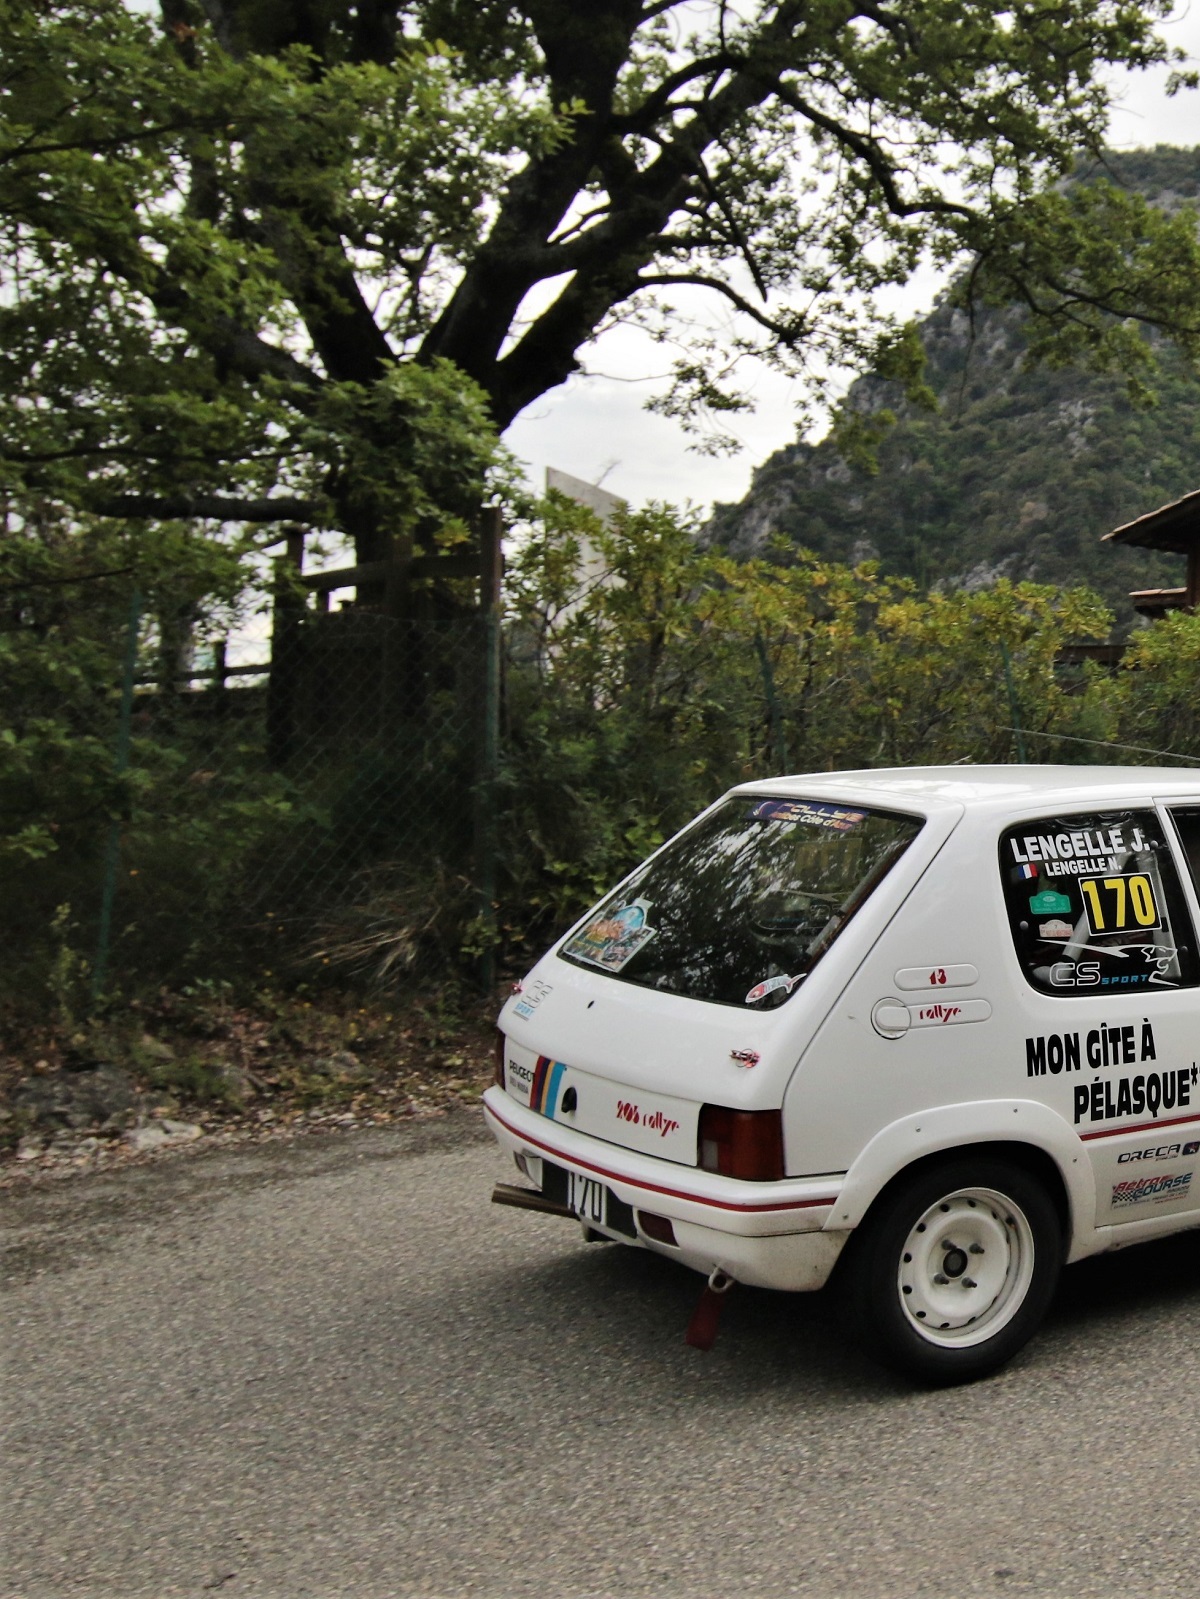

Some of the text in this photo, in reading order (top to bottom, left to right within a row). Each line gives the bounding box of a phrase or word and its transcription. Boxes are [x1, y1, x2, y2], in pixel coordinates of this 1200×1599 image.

[1010, 828, 1150, 863] LENGELLE J.
[1045, 857, 1123, 877] LENGELLE N.
[1081, 875, 1156, 931] 170
[1050, 961, 1149, 987] CS SPORT
[919, 1004, 962, 1023] rallye
[1026, 1018, 1157, 1077] MON GÎTE À
[509, 1059, 536, 1083] PEUGEOT
[643, 1111, 680, 1137] rallye
[1117, 1143, 1181, 1164] ORECA
[568, 1171, 603, 1223] 170
[1133, 1172, 1193, 1199] COURSE
